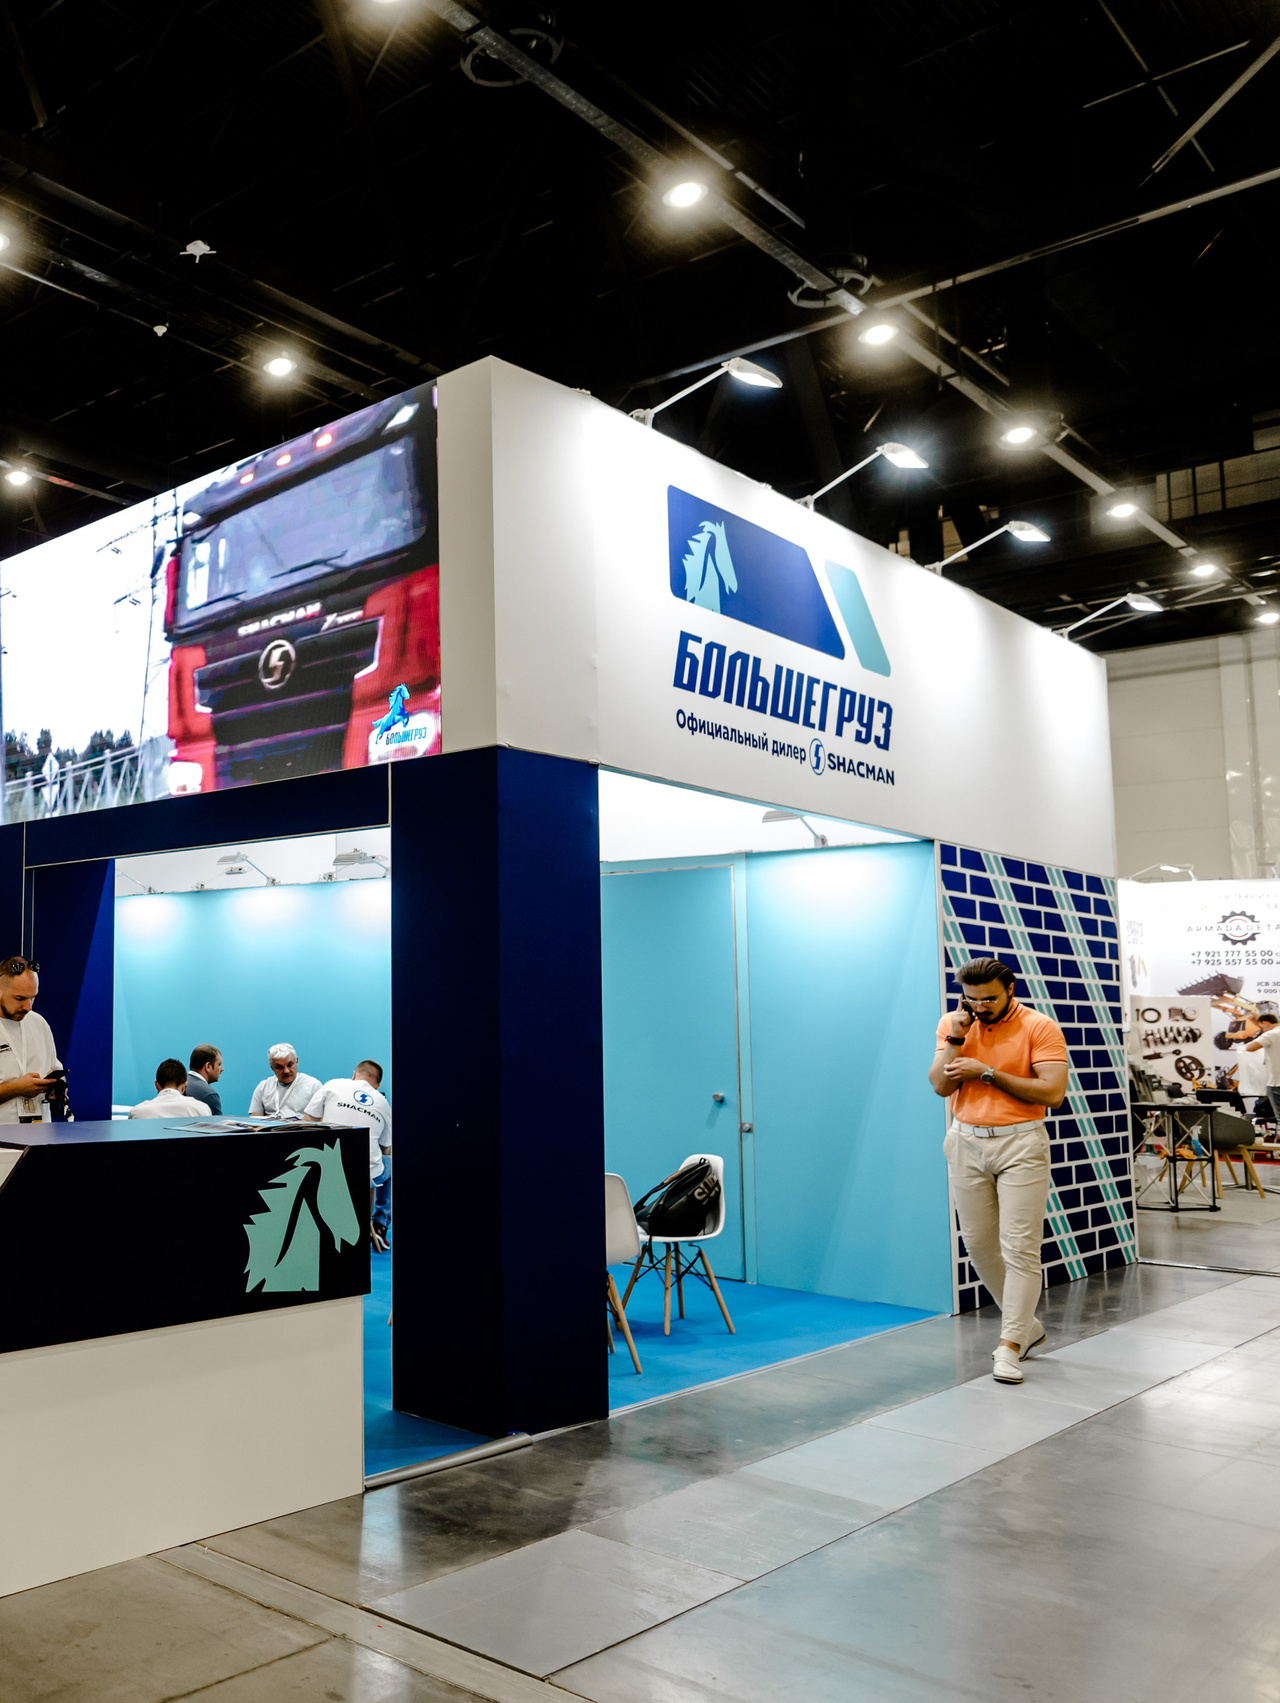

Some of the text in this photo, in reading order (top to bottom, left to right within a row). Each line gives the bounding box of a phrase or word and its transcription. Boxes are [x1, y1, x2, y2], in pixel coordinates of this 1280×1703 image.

[673, 630, 893, 751] БОЛЬШЕГРУЗ
[386, 727, 427, 745] БОЛЬШЕГРУЗ
[676, 709, 895, 786] Официальный дилер SHACMAN
[337, 1102, 381, 1123] SHACMAN
